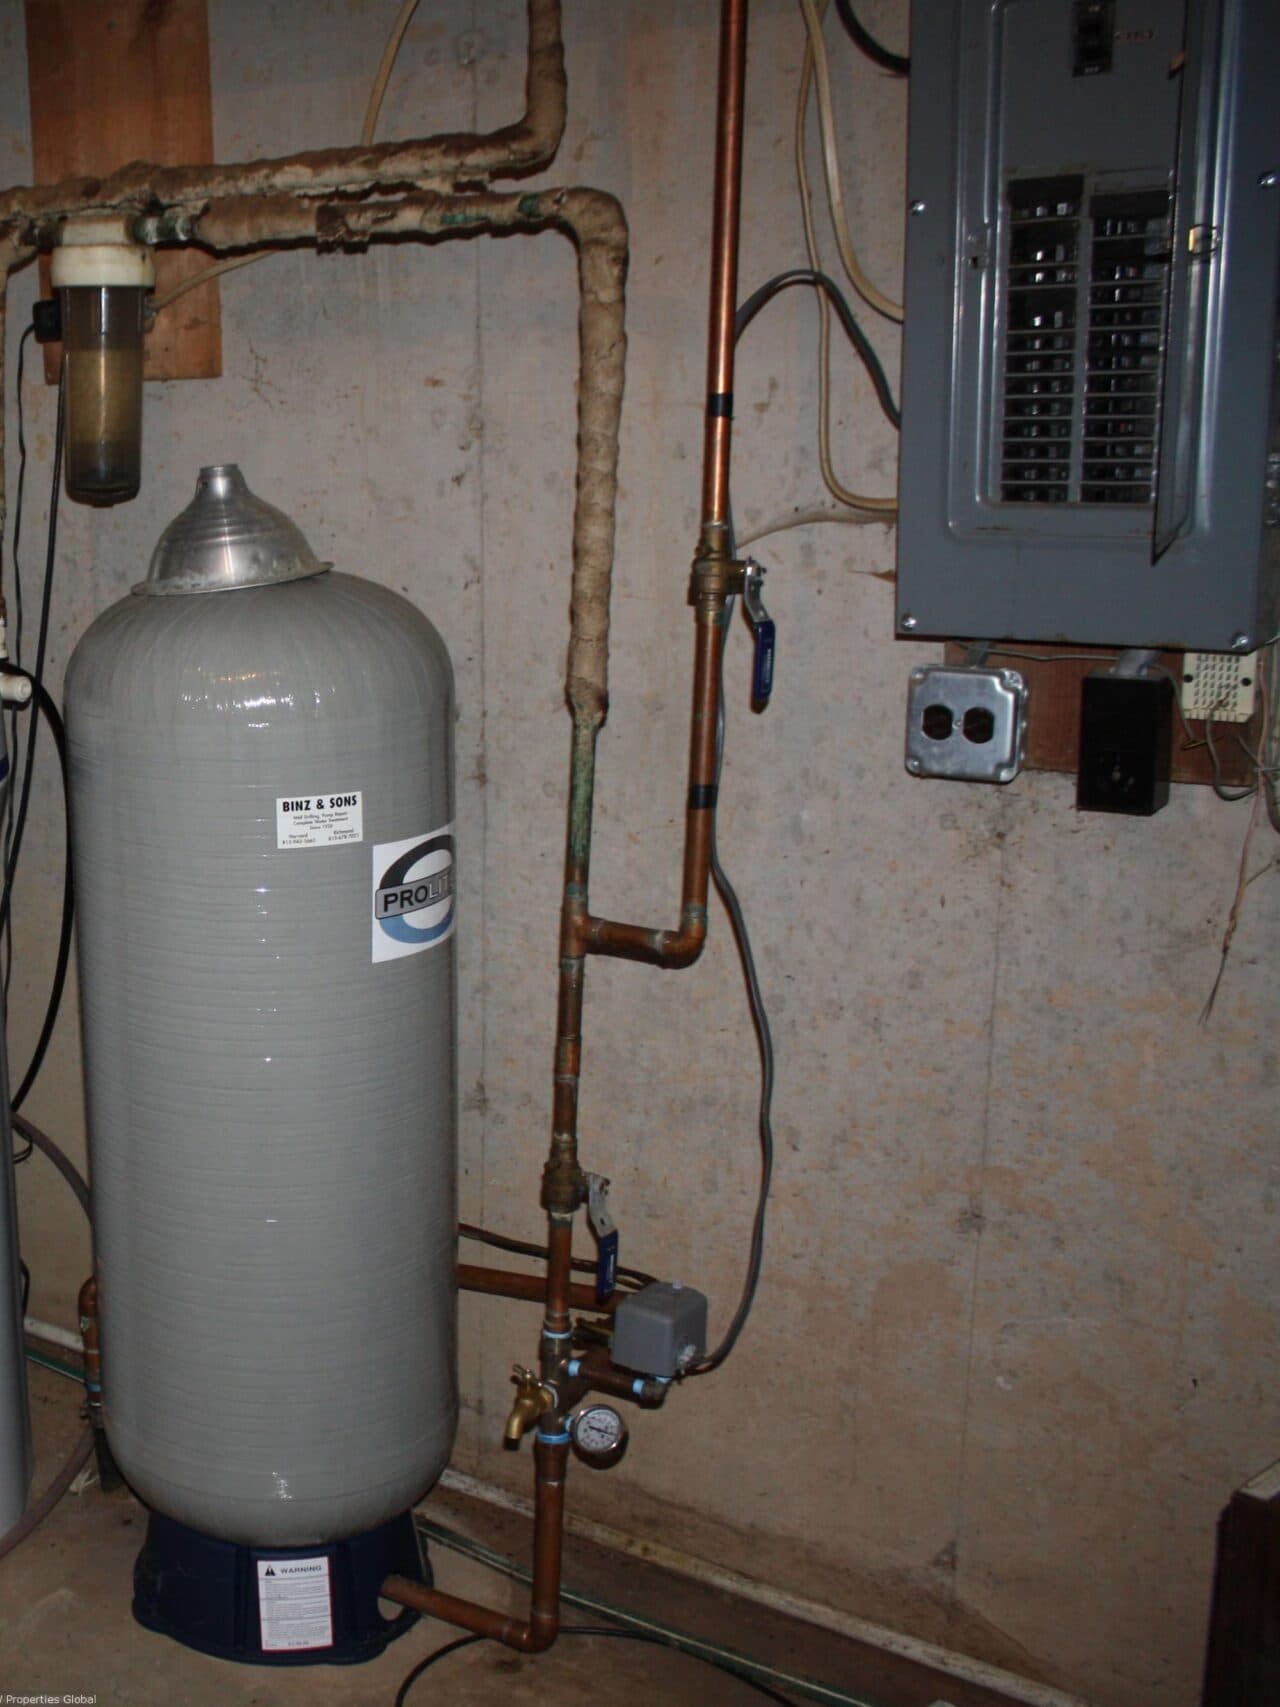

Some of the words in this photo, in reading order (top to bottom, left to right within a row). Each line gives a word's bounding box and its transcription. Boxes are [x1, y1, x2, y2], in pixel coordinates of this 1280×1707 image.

[282, 799, 311, 813] BINZ
[316, 798, 325, 810] &
[329, 794, 357, 809] SONS
[280, 1564, 322, 1574] WARNING
